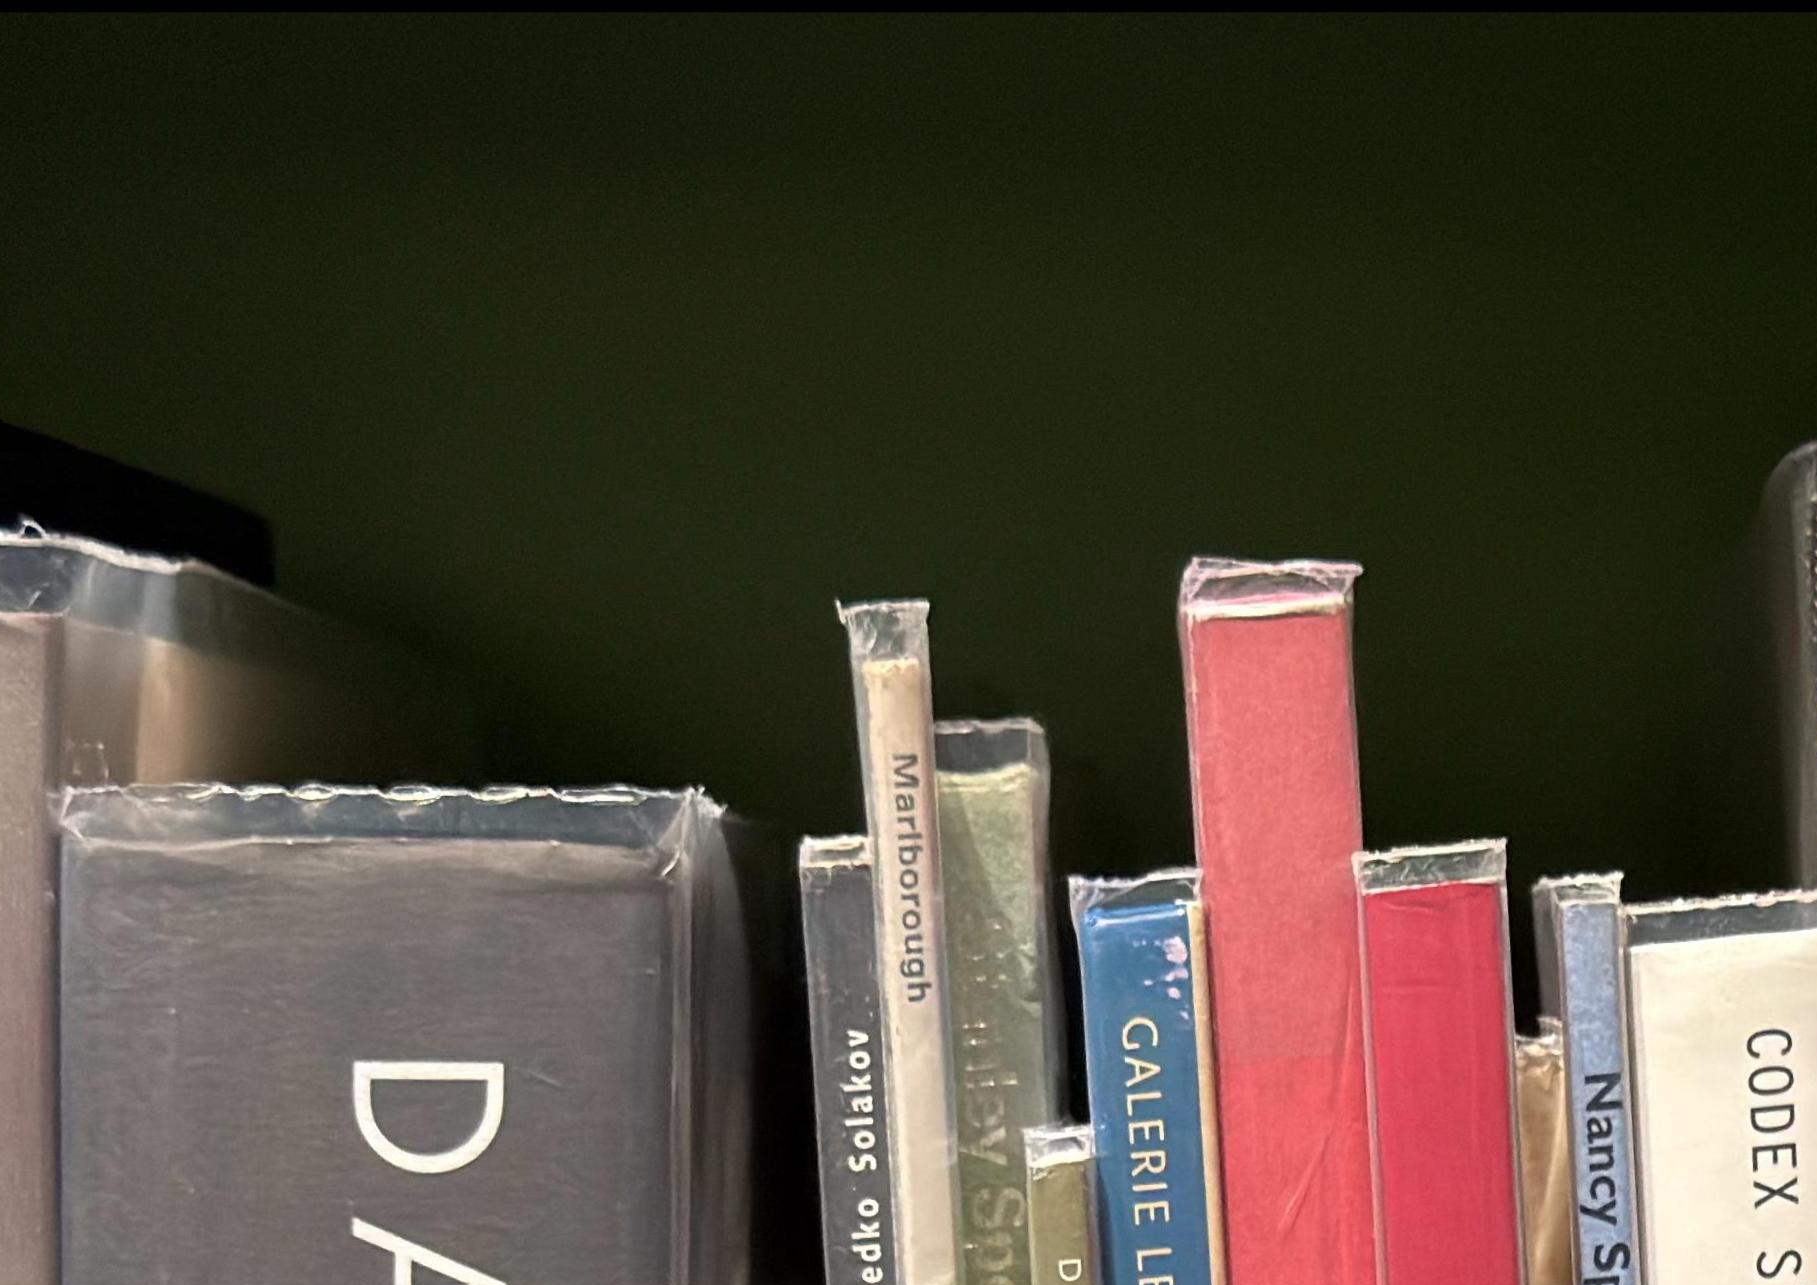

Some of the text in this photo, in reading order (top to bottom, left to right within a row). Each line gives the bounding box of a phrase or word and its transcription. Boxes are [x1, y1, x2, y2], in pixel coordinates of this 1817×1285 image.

[892, 753, 931, 1002] Marlborough
[846, 1030, 878, 1172] Solakov
[1122, 1017, 1169, 1225] GALERIE
[1579, 1070, 1621, 1225] Nancy
[1747, 1028, 1799, 1210] CODEX
